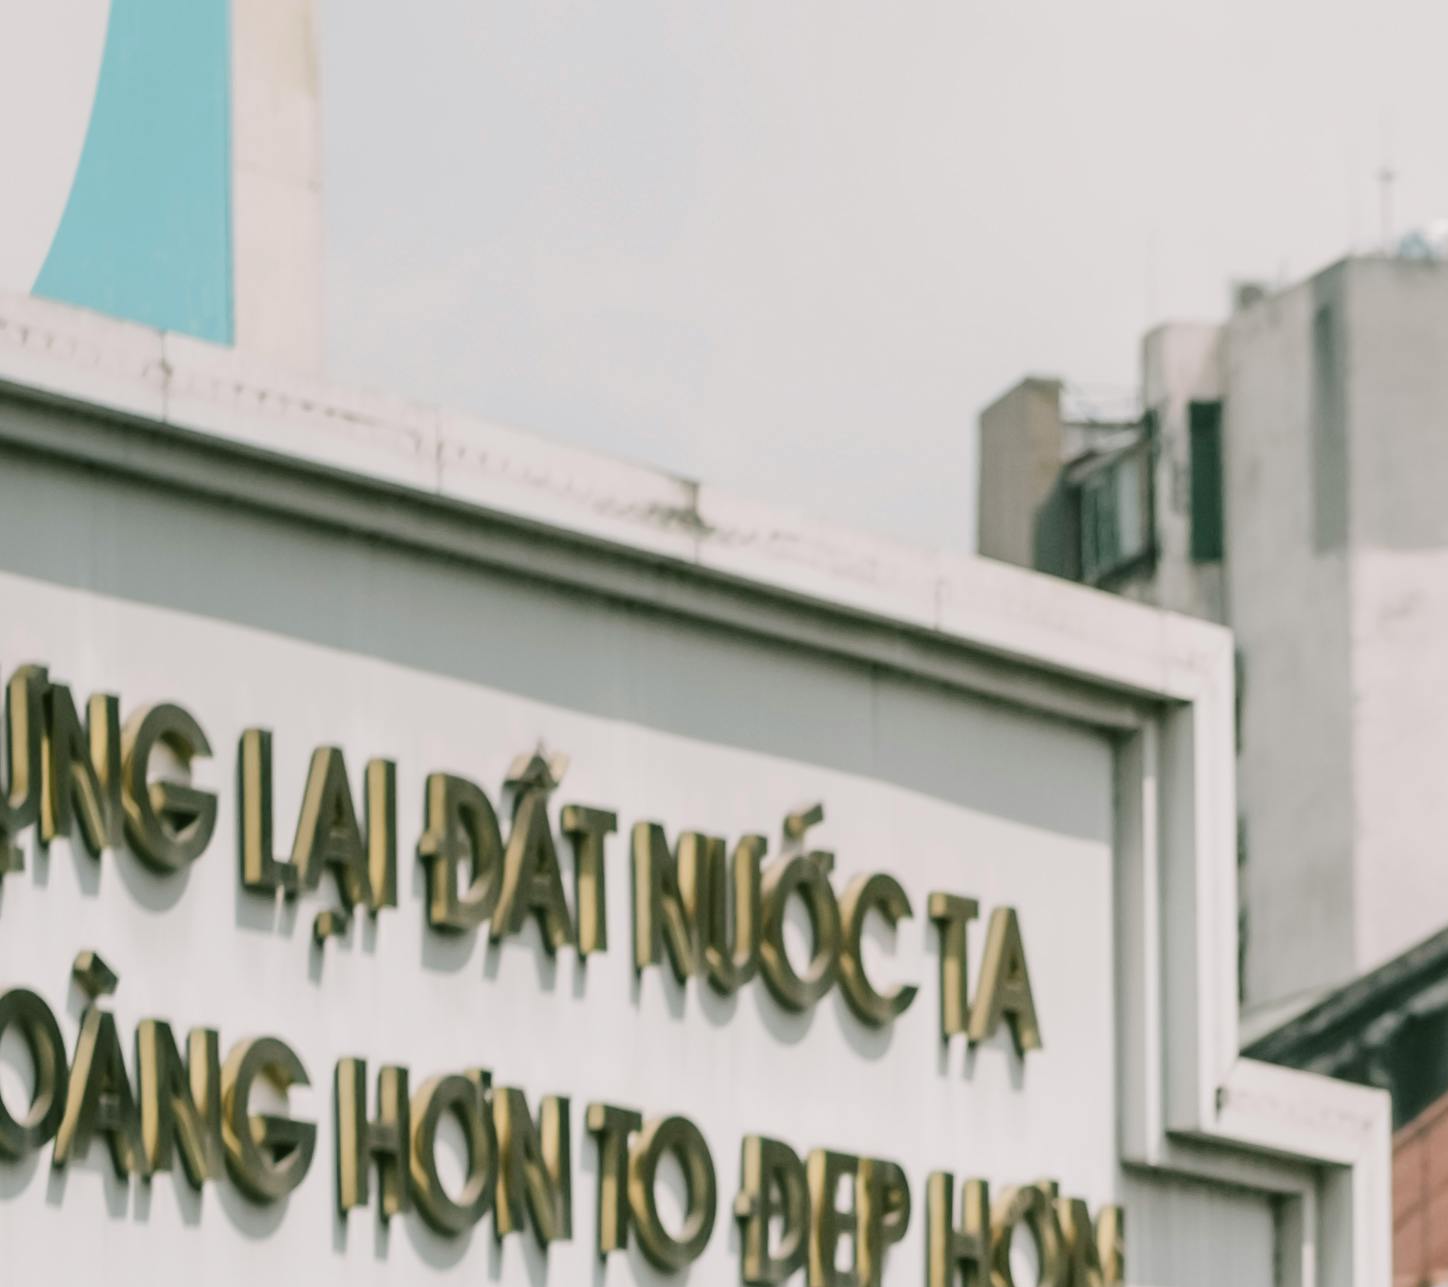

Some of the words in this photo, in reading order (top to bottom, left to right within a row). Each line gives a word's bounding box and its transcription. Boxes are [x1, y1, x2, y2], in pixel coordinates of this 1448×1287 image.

[236, 727, 398, 947] LẠI
[416, 742, 617, 963] ĐẤT
[630, 802, 918, 1030] NƯỚC
[926, 890, 1043, 1060] TA
[334, 1056, 573, 1250] HƠN
[586, 1102, 717, 1276] TO
